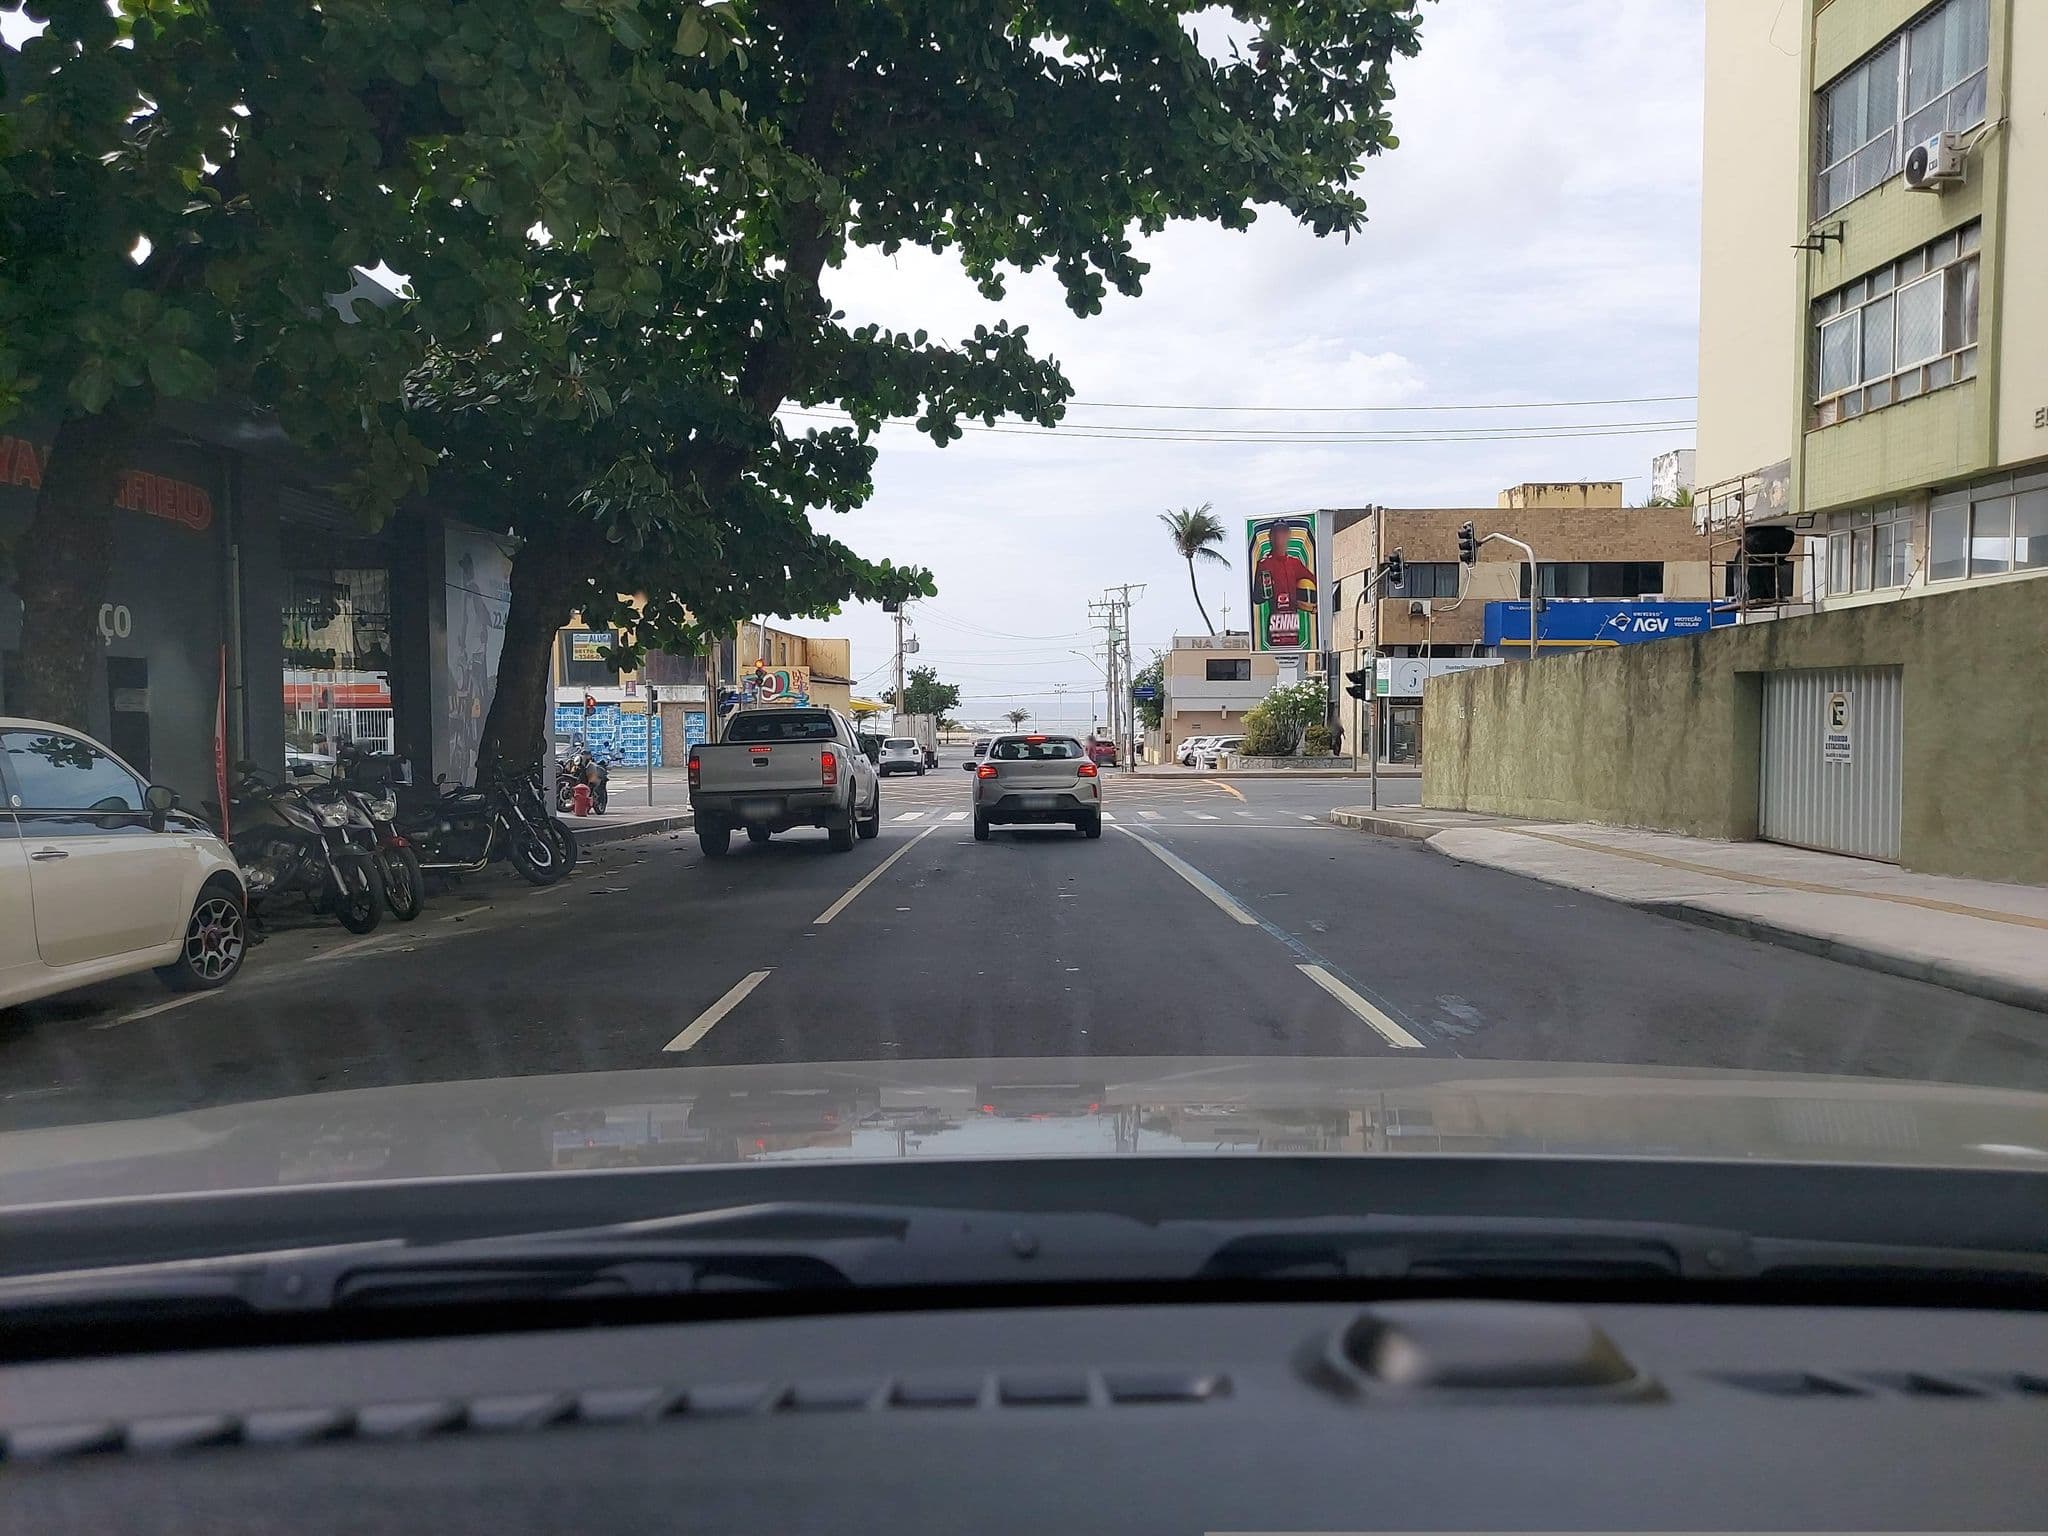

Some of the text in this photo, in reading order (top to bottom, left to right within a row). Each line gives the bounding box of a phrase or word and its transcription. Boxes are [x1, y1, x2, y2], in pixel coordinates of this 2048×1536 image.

[2035, 407, 2048, 429] E
[1269, 613, 1300, 631] SENNA
[1632, 617, 1670, 633] AGV
